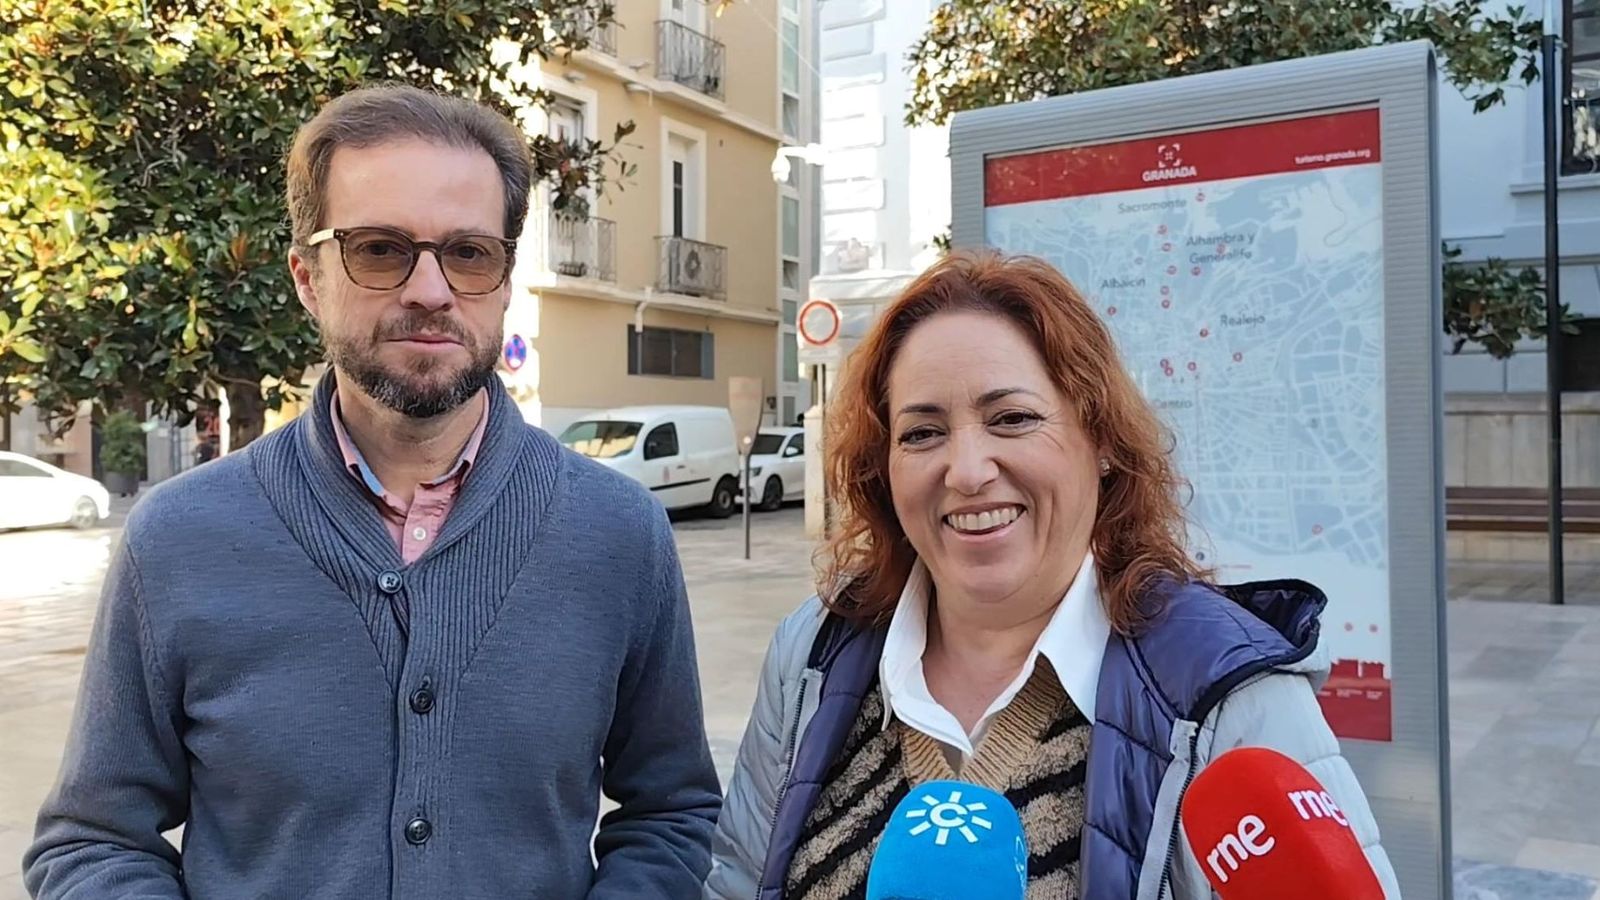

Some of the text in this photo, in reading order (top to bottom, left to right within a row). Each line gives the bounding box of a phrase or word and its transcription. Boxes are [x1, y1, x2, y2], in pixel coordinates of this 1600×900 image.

[1142, 166, 1197, 182] GRANADA
[1118, 199, 1187, 214] Sacromonte
[1186, 232, 1255, 246] Alhambra y
[1220, 314, 1266, 328] Realejo
[1287, 789, 1348, 827] rne
[1206, 814, 1275, 883] rne
